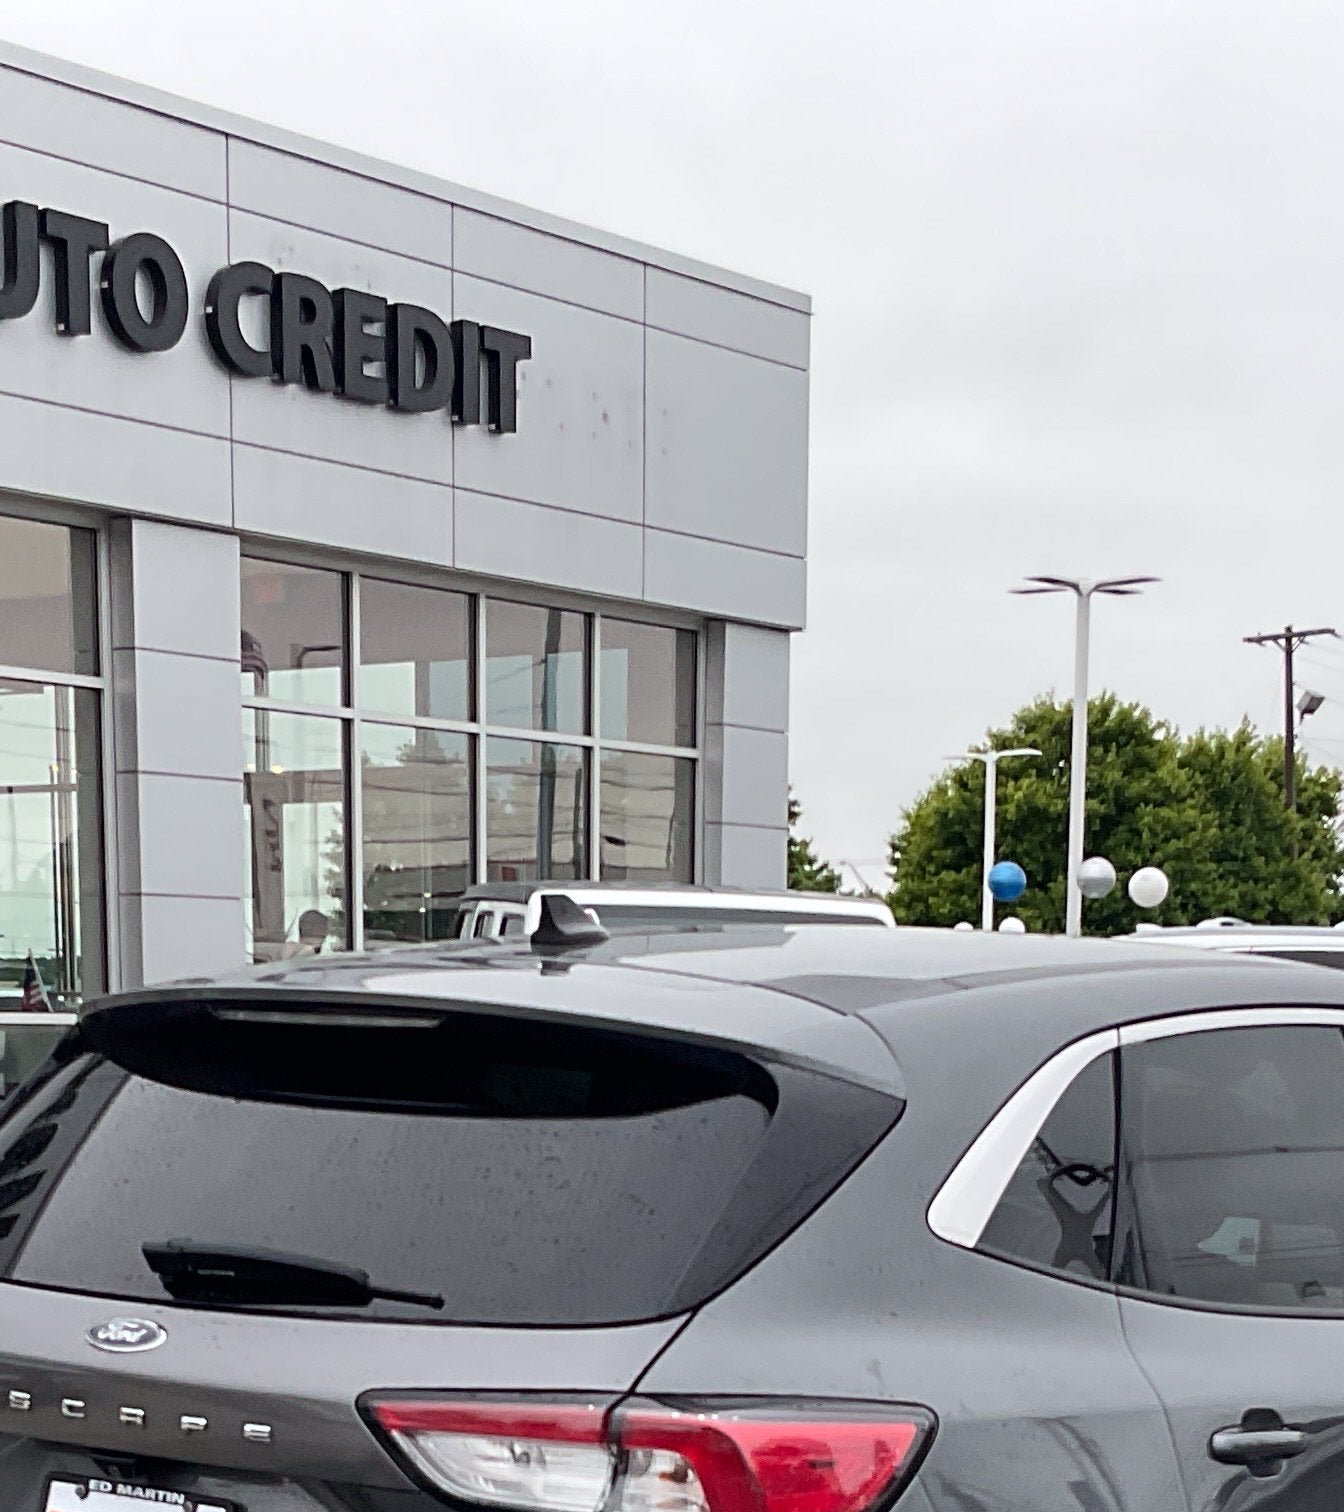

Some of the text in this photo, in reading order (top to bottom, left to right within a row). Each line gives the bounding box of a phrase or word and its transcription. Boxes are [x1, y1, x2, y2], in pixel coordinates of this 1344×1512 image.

[204, 260, 532, 434] CREDIT
[88, 1479, 185, 1505] ED MARTIN
